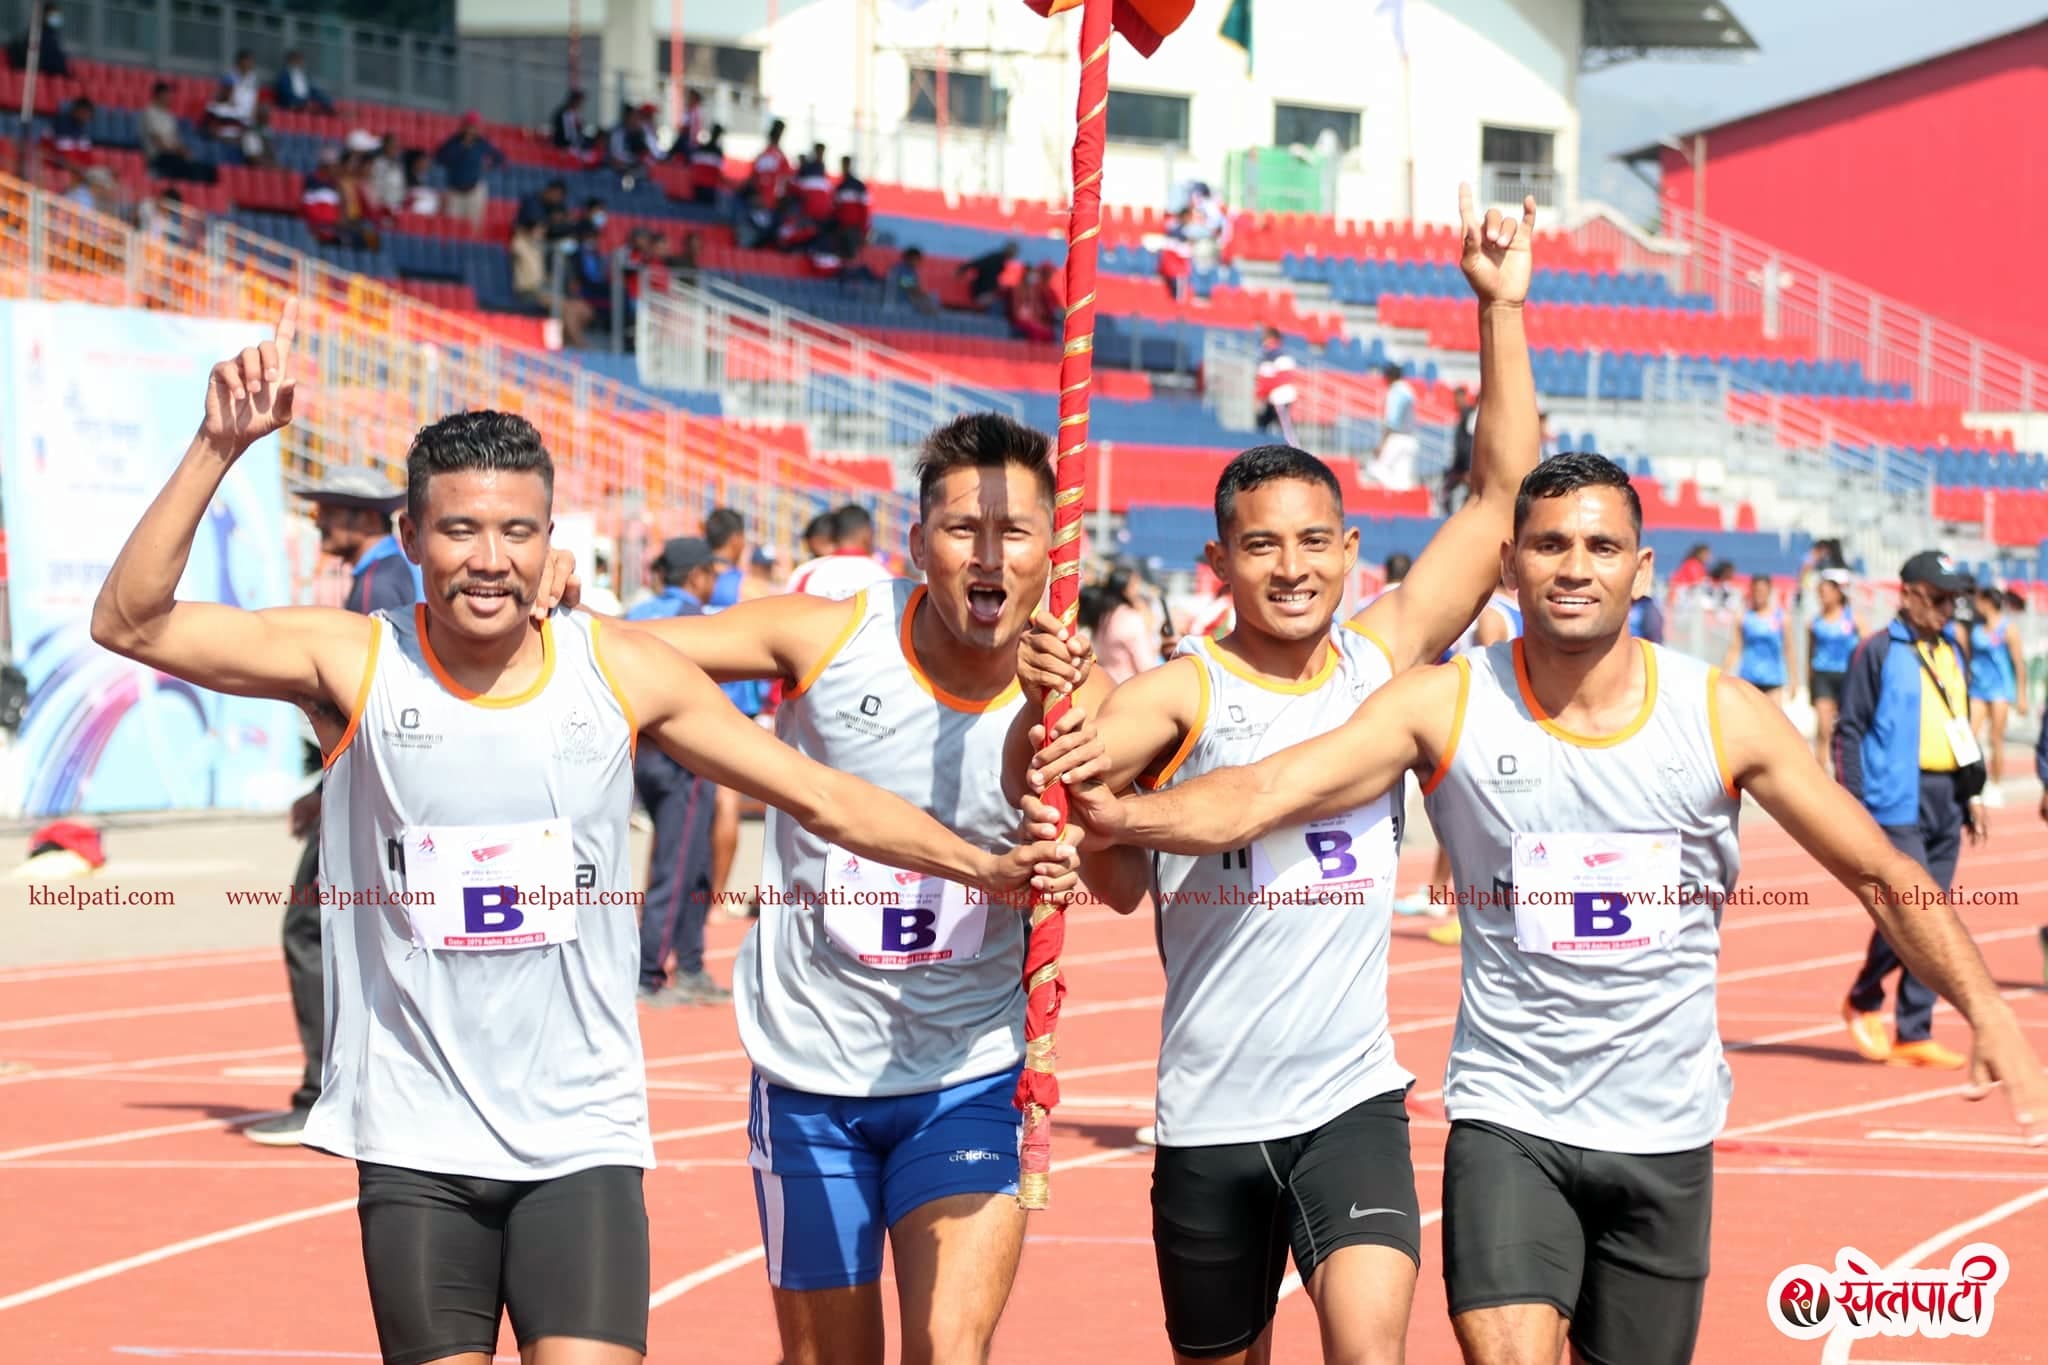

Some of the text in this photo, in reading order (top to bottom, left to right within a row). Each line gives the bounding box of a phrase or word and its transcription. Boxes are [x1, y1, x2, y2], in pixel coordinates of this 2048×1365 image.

[1305, 830, 1357, 879] B
[463, 886, 524, 933] B
[882, 907, 937, 951] B
[1574, 892, 1632, 937] B
